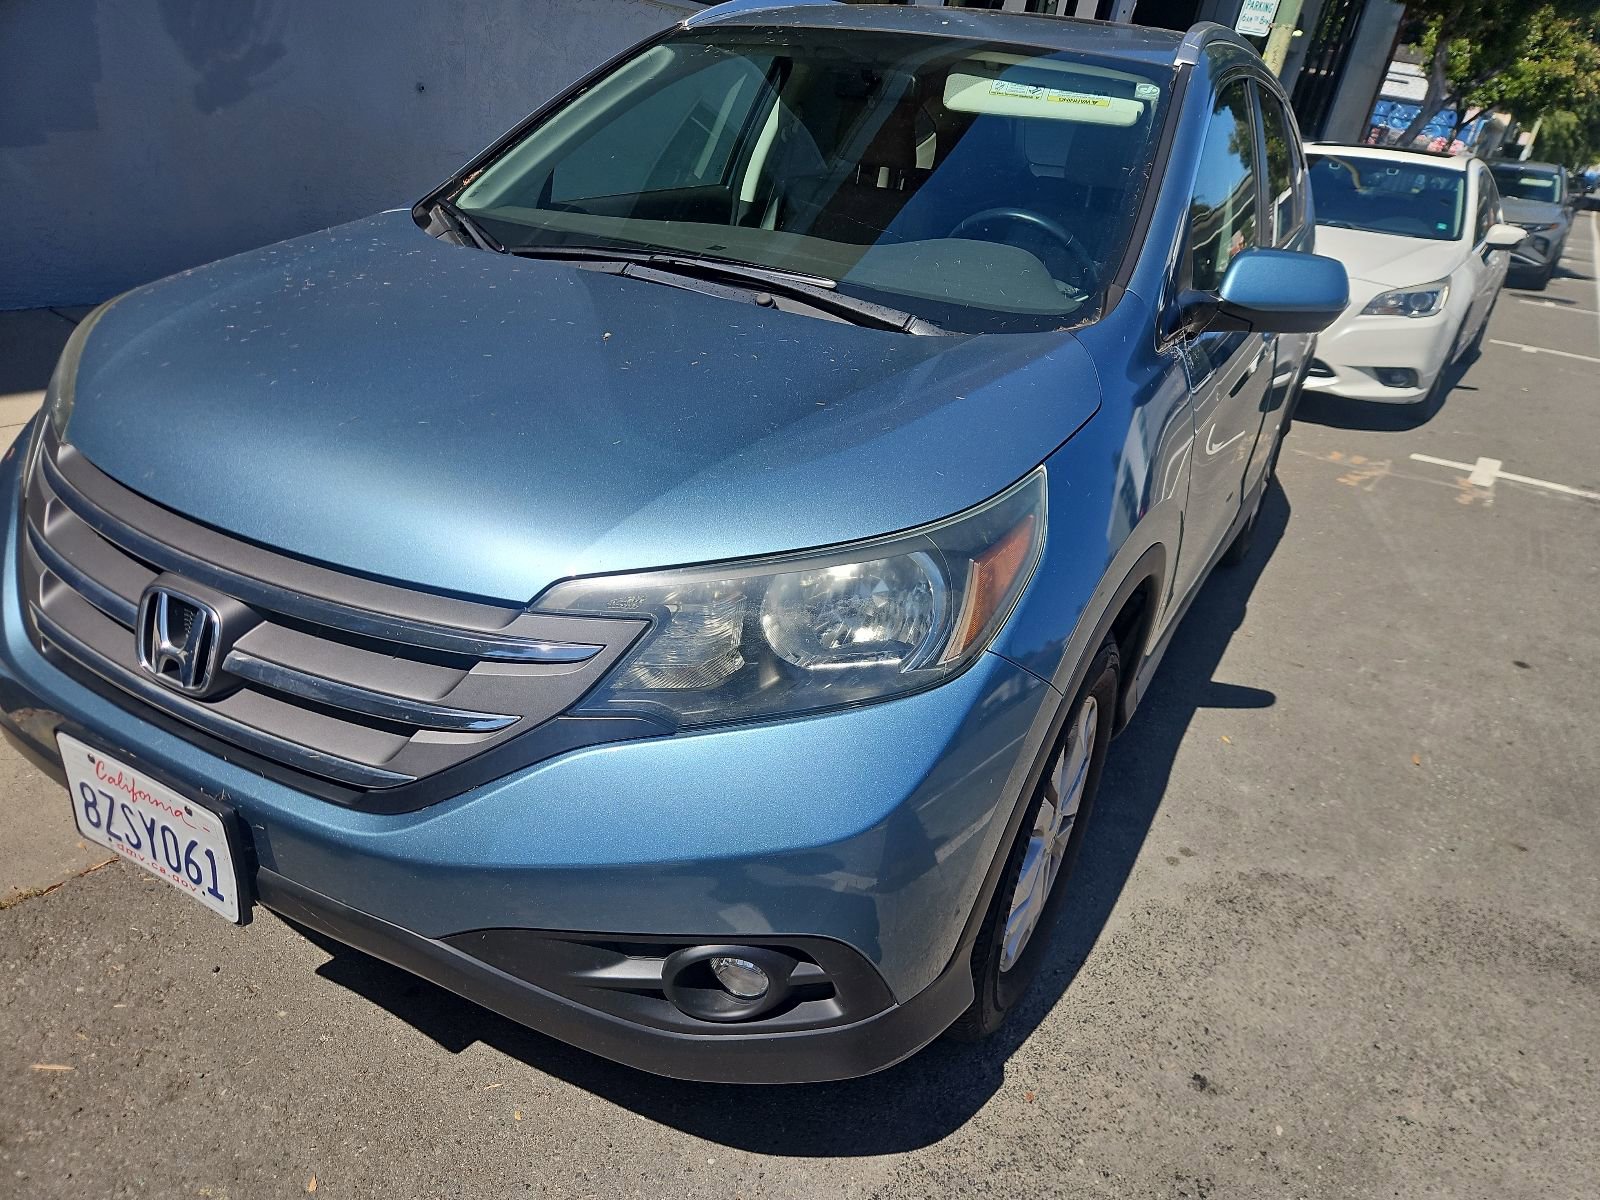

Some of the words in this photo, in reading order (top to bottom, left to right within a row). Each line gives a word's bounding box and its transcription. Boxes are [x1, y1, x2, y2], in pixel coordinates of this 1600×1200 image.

[95, 760, 197, 830] California
[79, 781, 225, 902] 8ZSY061
[116, 842, 197, 893] dmv.ca.gov
